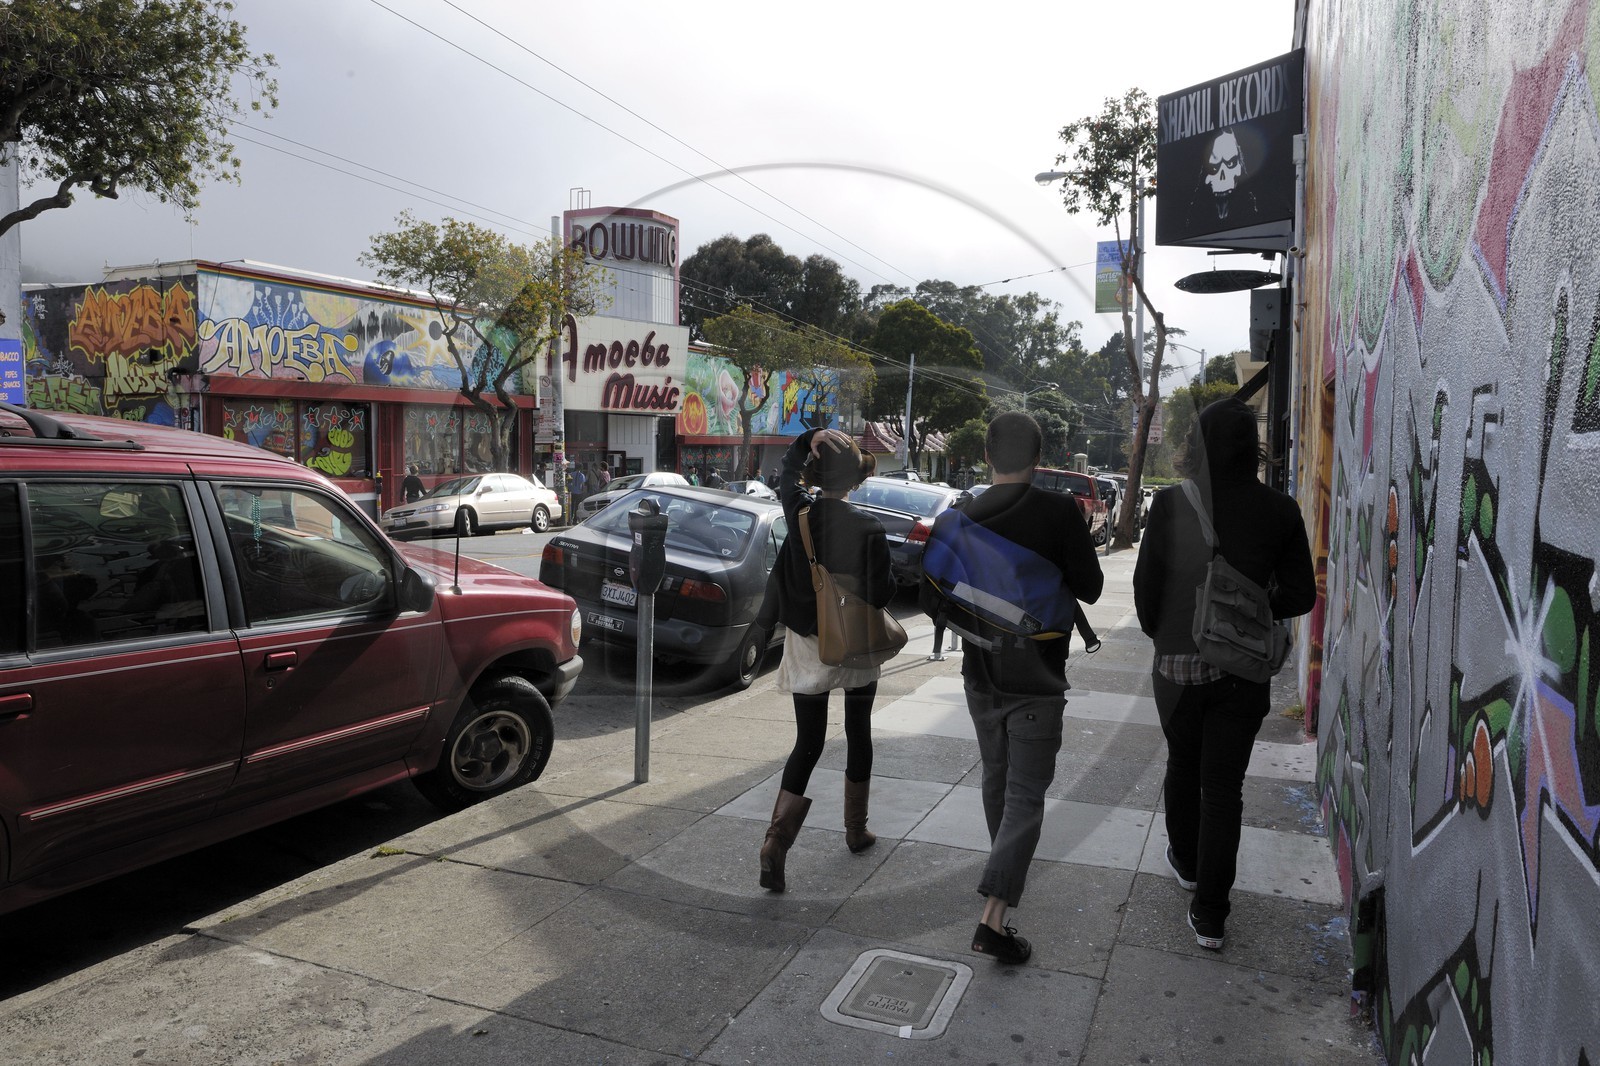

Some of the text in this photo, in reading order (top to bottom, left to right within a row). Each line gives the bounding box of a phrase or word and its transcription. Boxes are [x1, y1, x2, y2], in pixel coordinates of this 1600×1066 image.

[1160, 87, 1214, 145] SHAXUL
[571, 222, 677, 268] BOWLING
[199, 318, 358, 384] AMOEBA
[547, 313, 671, 383] Amoeba
[601, 372, 680, 412] Music
[558, 540, 580, 550] SENTRA
[602, 586, 636, 605] 3XIJ402
[866, 1000, 910, 1014] PACIFIC
[876, 995, 908, 1007] BELL
